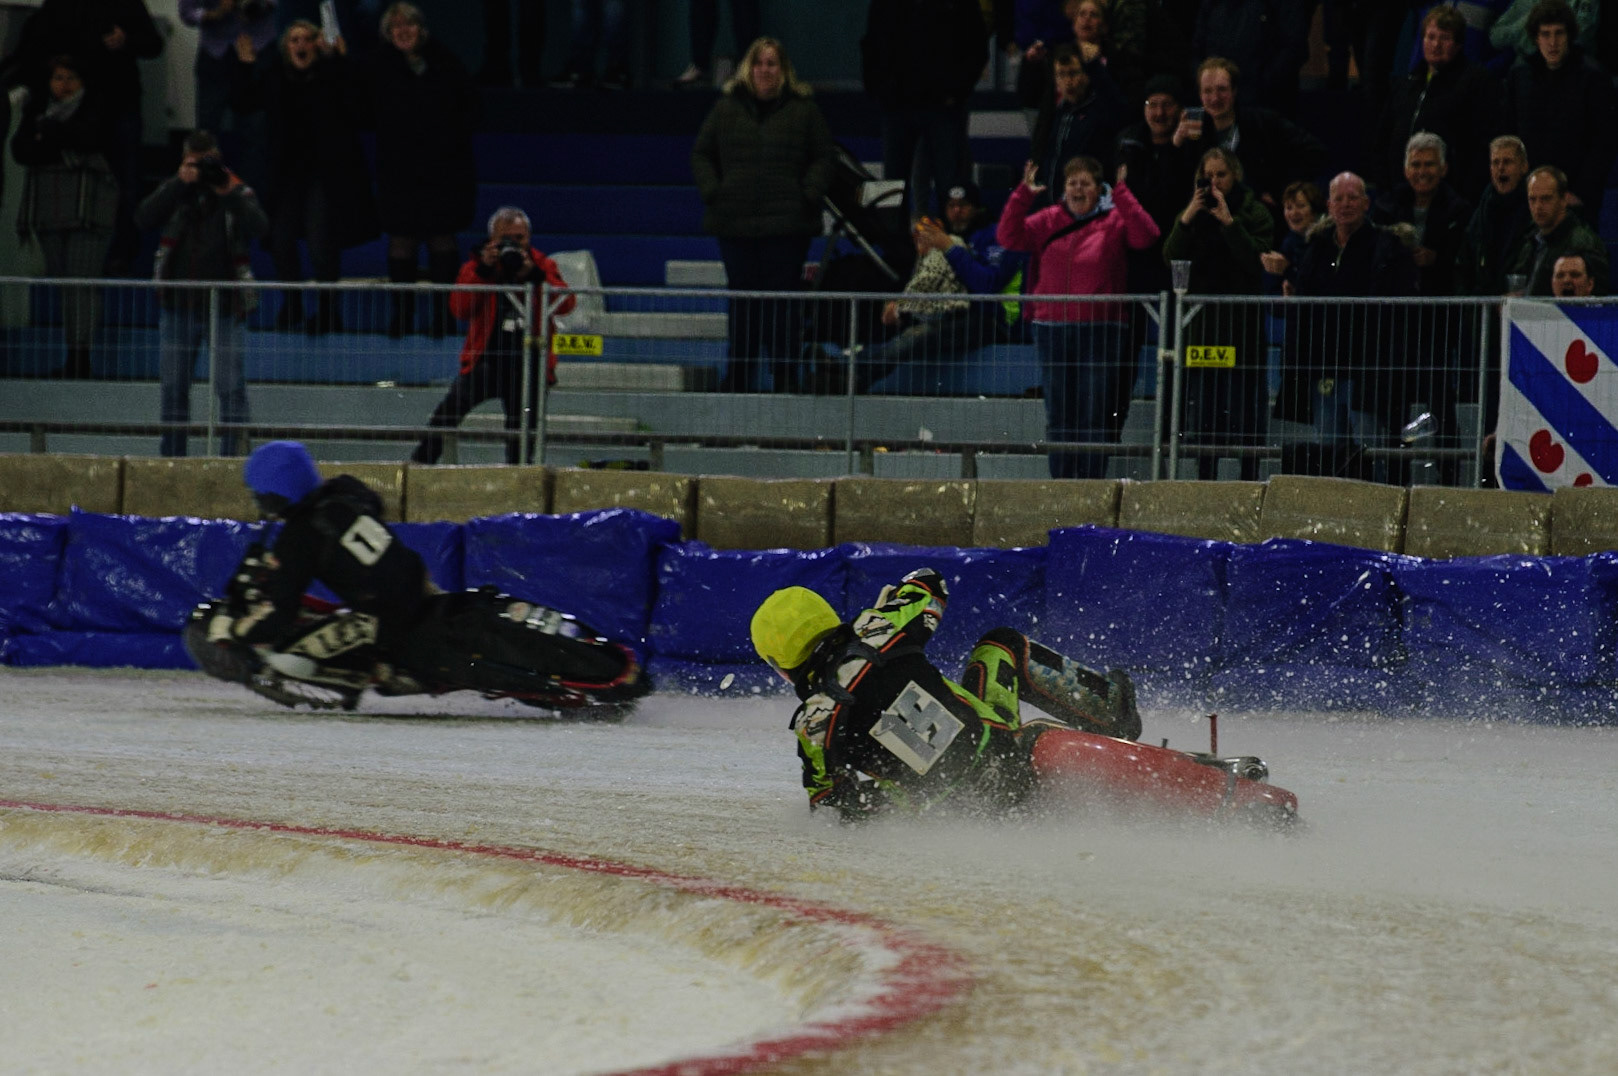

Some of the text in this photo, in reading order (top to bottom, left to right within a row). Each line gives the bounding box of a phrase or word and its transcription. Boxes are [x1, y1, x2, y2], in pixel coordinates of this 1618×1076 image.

[1190, 348, 1229, 361] D.E.V.
[352, 532, 376, 553] 1
[880, 688, 960, 765] 15
